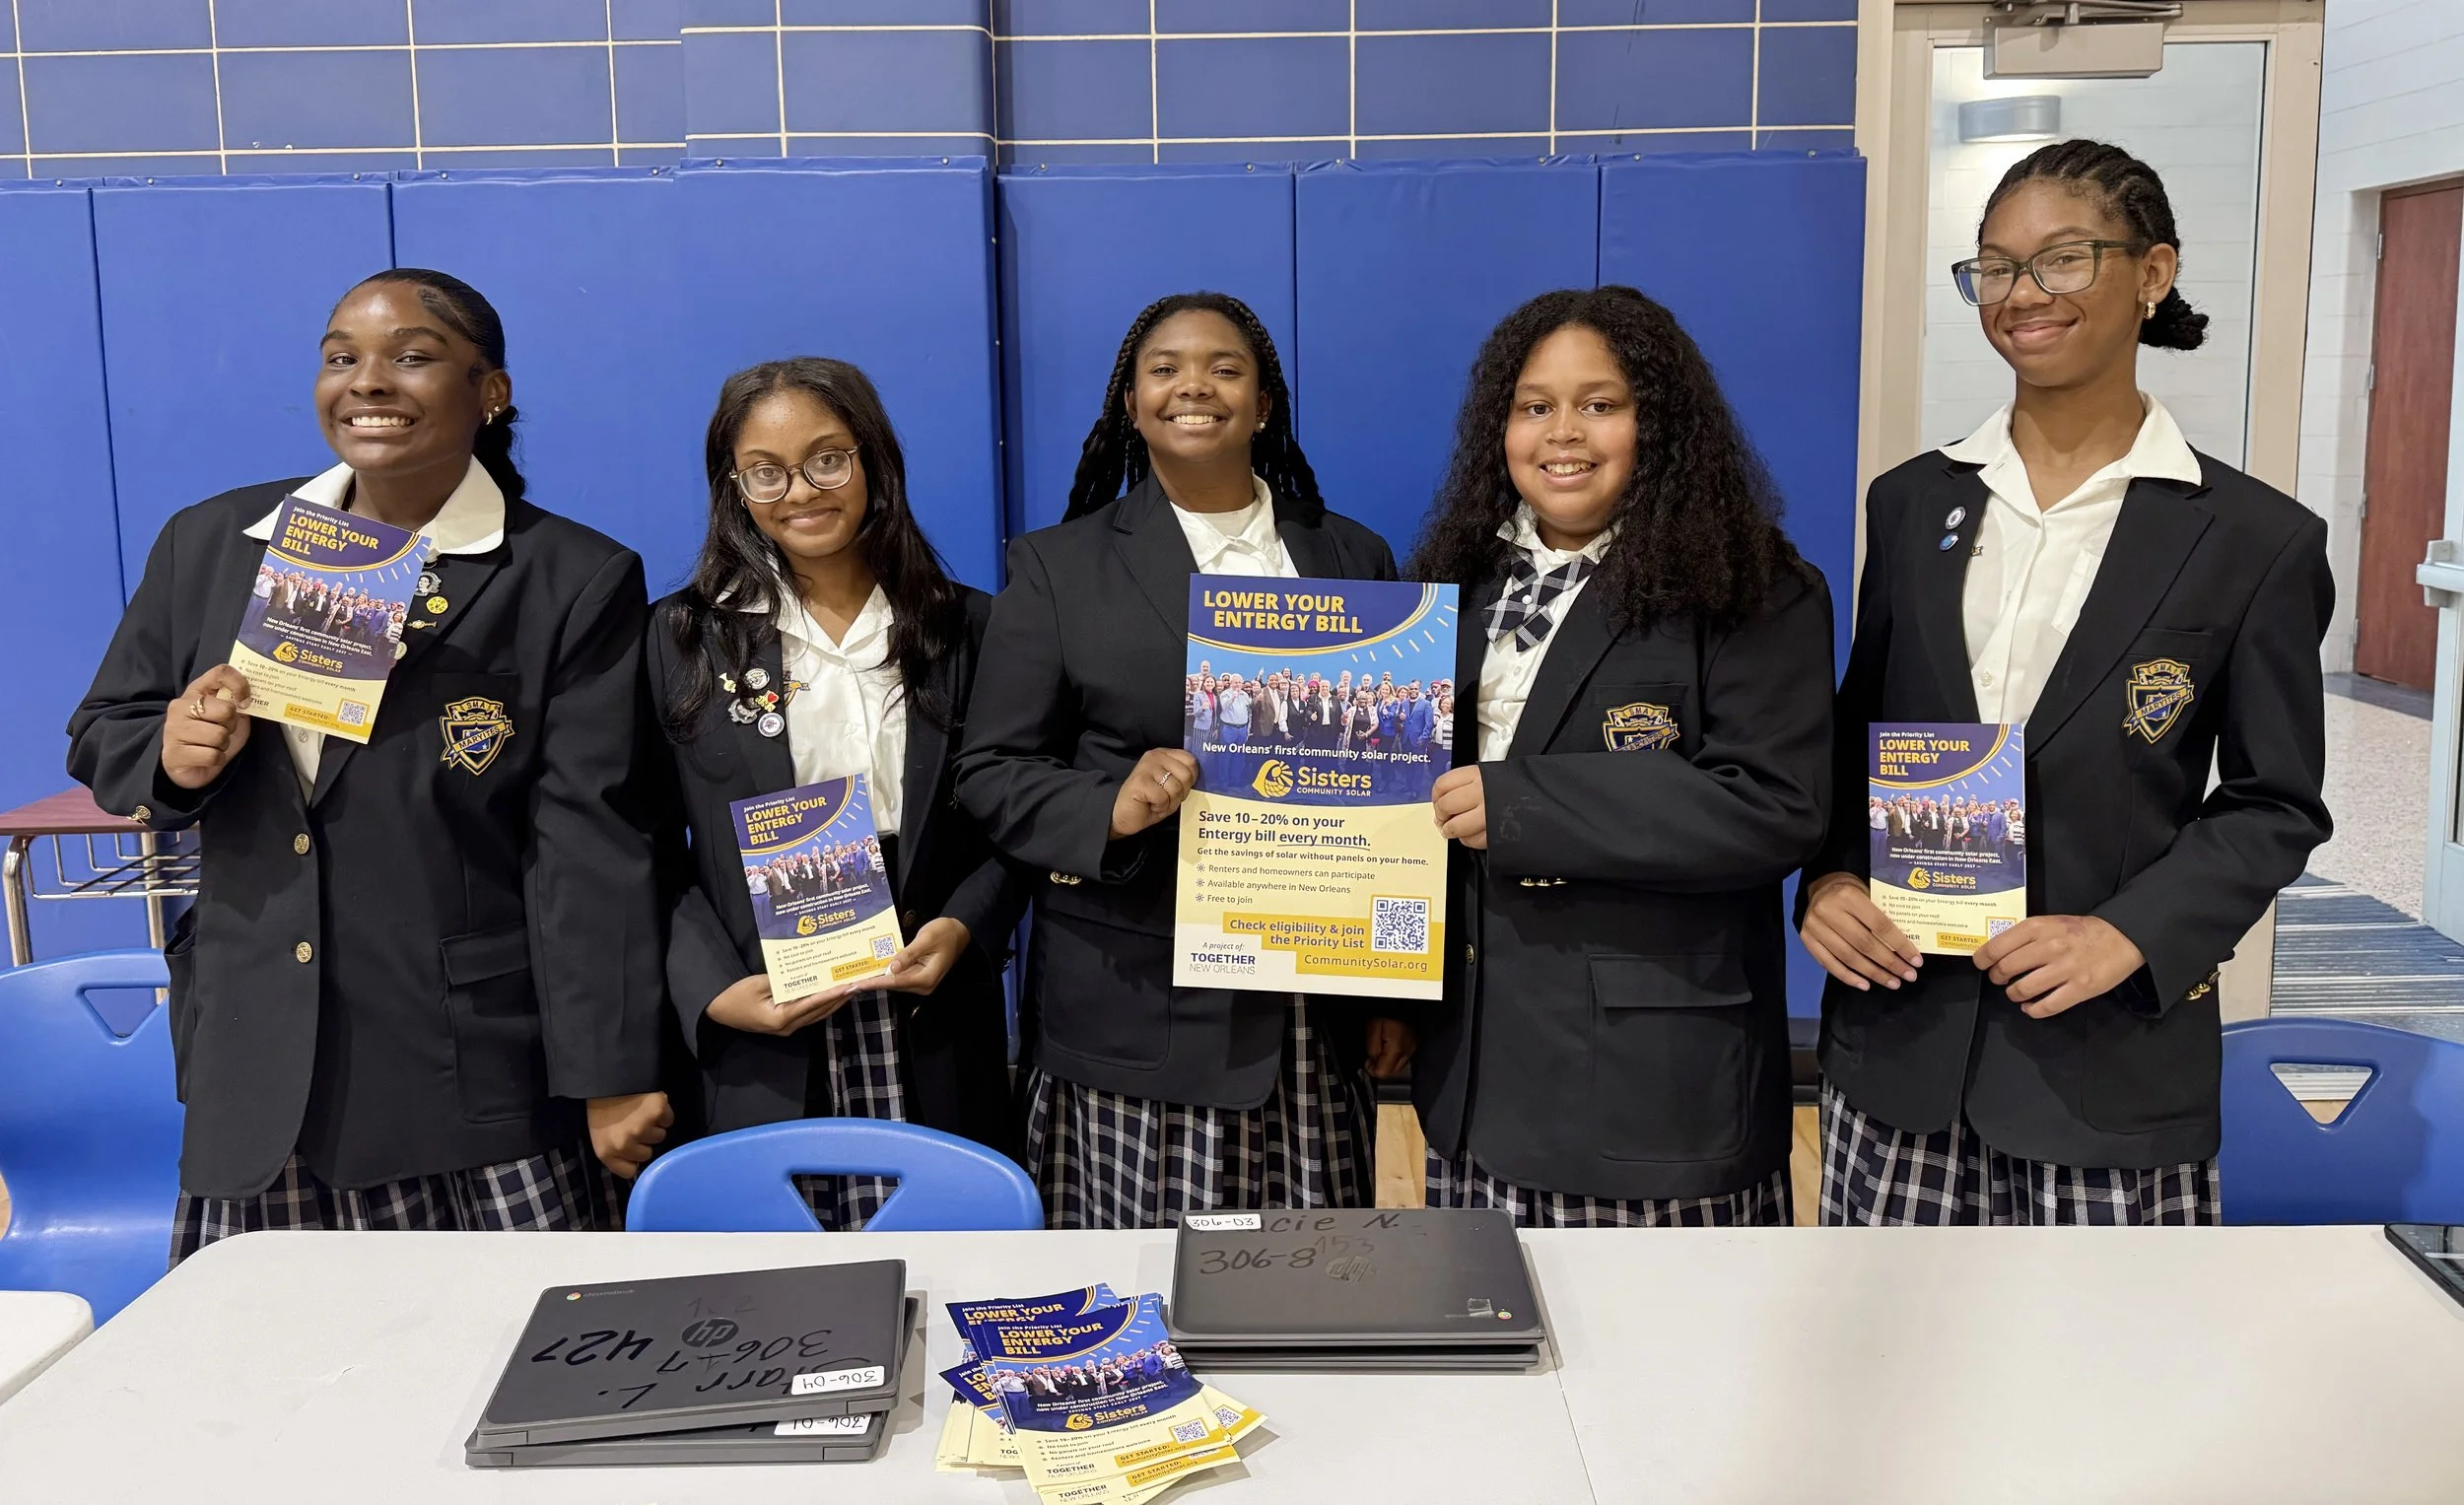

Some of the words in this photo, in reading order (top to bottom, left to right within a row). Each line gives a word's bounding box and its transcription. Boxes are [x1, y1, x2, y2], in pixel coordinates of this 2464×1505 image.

[316, 513, 338, 523] Priority
[286, 525, 347, 552] ENTERGY
[290, 513, 337, 536] LOWER
[341, 529, 378, 549] YOUR
[282, 537, 310, 555] BILL
[1204, 590, 1279, 610] LOWER
[1285, 595, 1344, 613] YOUR
[1214, 610, 1310, 631] ENTERGY
[1316, 615, 1363, 634] BILL
[300, 650, 343, 669] Sisters
[466, 701, 486, 710] SMA
[1628, 707, 1649, 716] SMA
[2141, 691, 2181, 717] MARYITES
[458, 725, 500, 749] MARYITES
[1202, 742, 1227, 753] New
[1229, 743, 1272, 755] Orleans'
[1275, 745, 1296, 755] first
[1299, 747, 1360, 761] community
[1362, 750, 1388, 761] solar
[1391, 751, 1431, 764] project.
[1880, 739, 1926, 751] LOWER
[1929, 740, 1970, 752] YOUR
[1880, 752, 1940, 764] ENTERGY
[1298, 767, 1372, 788] Sisters
[1880, 764, 1909, 776] BILL
[745, 805, 789, 823] LOWER
[791, 796, 827, 812] YOUR
[748, 813, 803, 834] ENTERGY
[1198, 810, 1231, 823] Save
[1292, 817, 1309, 827] on
[1313, 818, 1345, 830] your
[750, 831, 779, 846] BILL
[1198, 828, 1252, 844] Entergy
[1256, 830, 1275, 842] bill
[1279, 834, 1317, 846] every
[1321, 834, 1372, 847] month.
[1197, 847, 1213, 855] Get
[1215, 848, 1229, 856] the
[1231, 850, 1264, 860] savings
[1266, 850, 1275, 859] of
[1276, 852, 1298, 860] solar
[1300, 853, 1334, 862] without
[1336, 854, 1364, 863] panels
[1380, 856, 1400, 865] your
[1402, 856, 1429, 866] home.
[1208, 864, 1240, 874] Renters
[1259, 866, 1313, 877] homeowners
[1331, 871, 1376, 881] participate
[1932, 871, 1976, 884] Sisters
[1207, 879, 1245, 889] Available
[1246, 882, 1286, 891] anywhere
[1299, 883, 1317, 893] New
[1319, 884, 1350, 894] Orleans
[1206, 894, 1225, 903] Free
[1237, 895, 1253, 906] join
[818, 909, 856, 924] Sisters
[1230, 920, 1266, 930] Check
[1269, 921, 1327, 934] eligibility
[1331, 924, 1338, 934] &
[1340, 924, 1365, 936] join
[1209, 942, 1235, 951] project
[1236, 942, 1245, 952] of:
[1269, 934, 1291, 944] the
[1293, 936, 1339, 950] Priority
[1342, 938, 1364, 948] List
[1191, 952, 1256, 965] TOGETHER
[1304, 954, 1428, 972] CommunitySolar.org
[1214, 964, 1256, 976] ORLEANS
[784, 976, 818, 989] TOGETHER
[1191, 1216, 1255, 1228] 306-03
[1199, 1247, 1317, 1274] 306-8
[964, 1309, 1019, 1321] LOWER
[1020, 1303, 1065, 1316] YOUR
[686, 1319, 736, 1348] hp
[998, 1330, 1056, 1338] LOWER
[1058, 1323, 1104, 1336] YOUR
[531, 1330, 654, 1366] 427
[1001, 1336, 1072, 1347] ENTERGY
[1005, 1346, 1041, 1355] BILL
[802, 1370, 877, 1390] 306-04
[1094, 1404, 1147, 1420] Sisters
[1135, 1444, 1171, 1456] STARTED:
[1047, 1464, 1095, 1474] TOGETHER
[1147, 1461, 1182, 1473] STARTED:
[1059, 1484, 1108, 1498] TOGETHER
